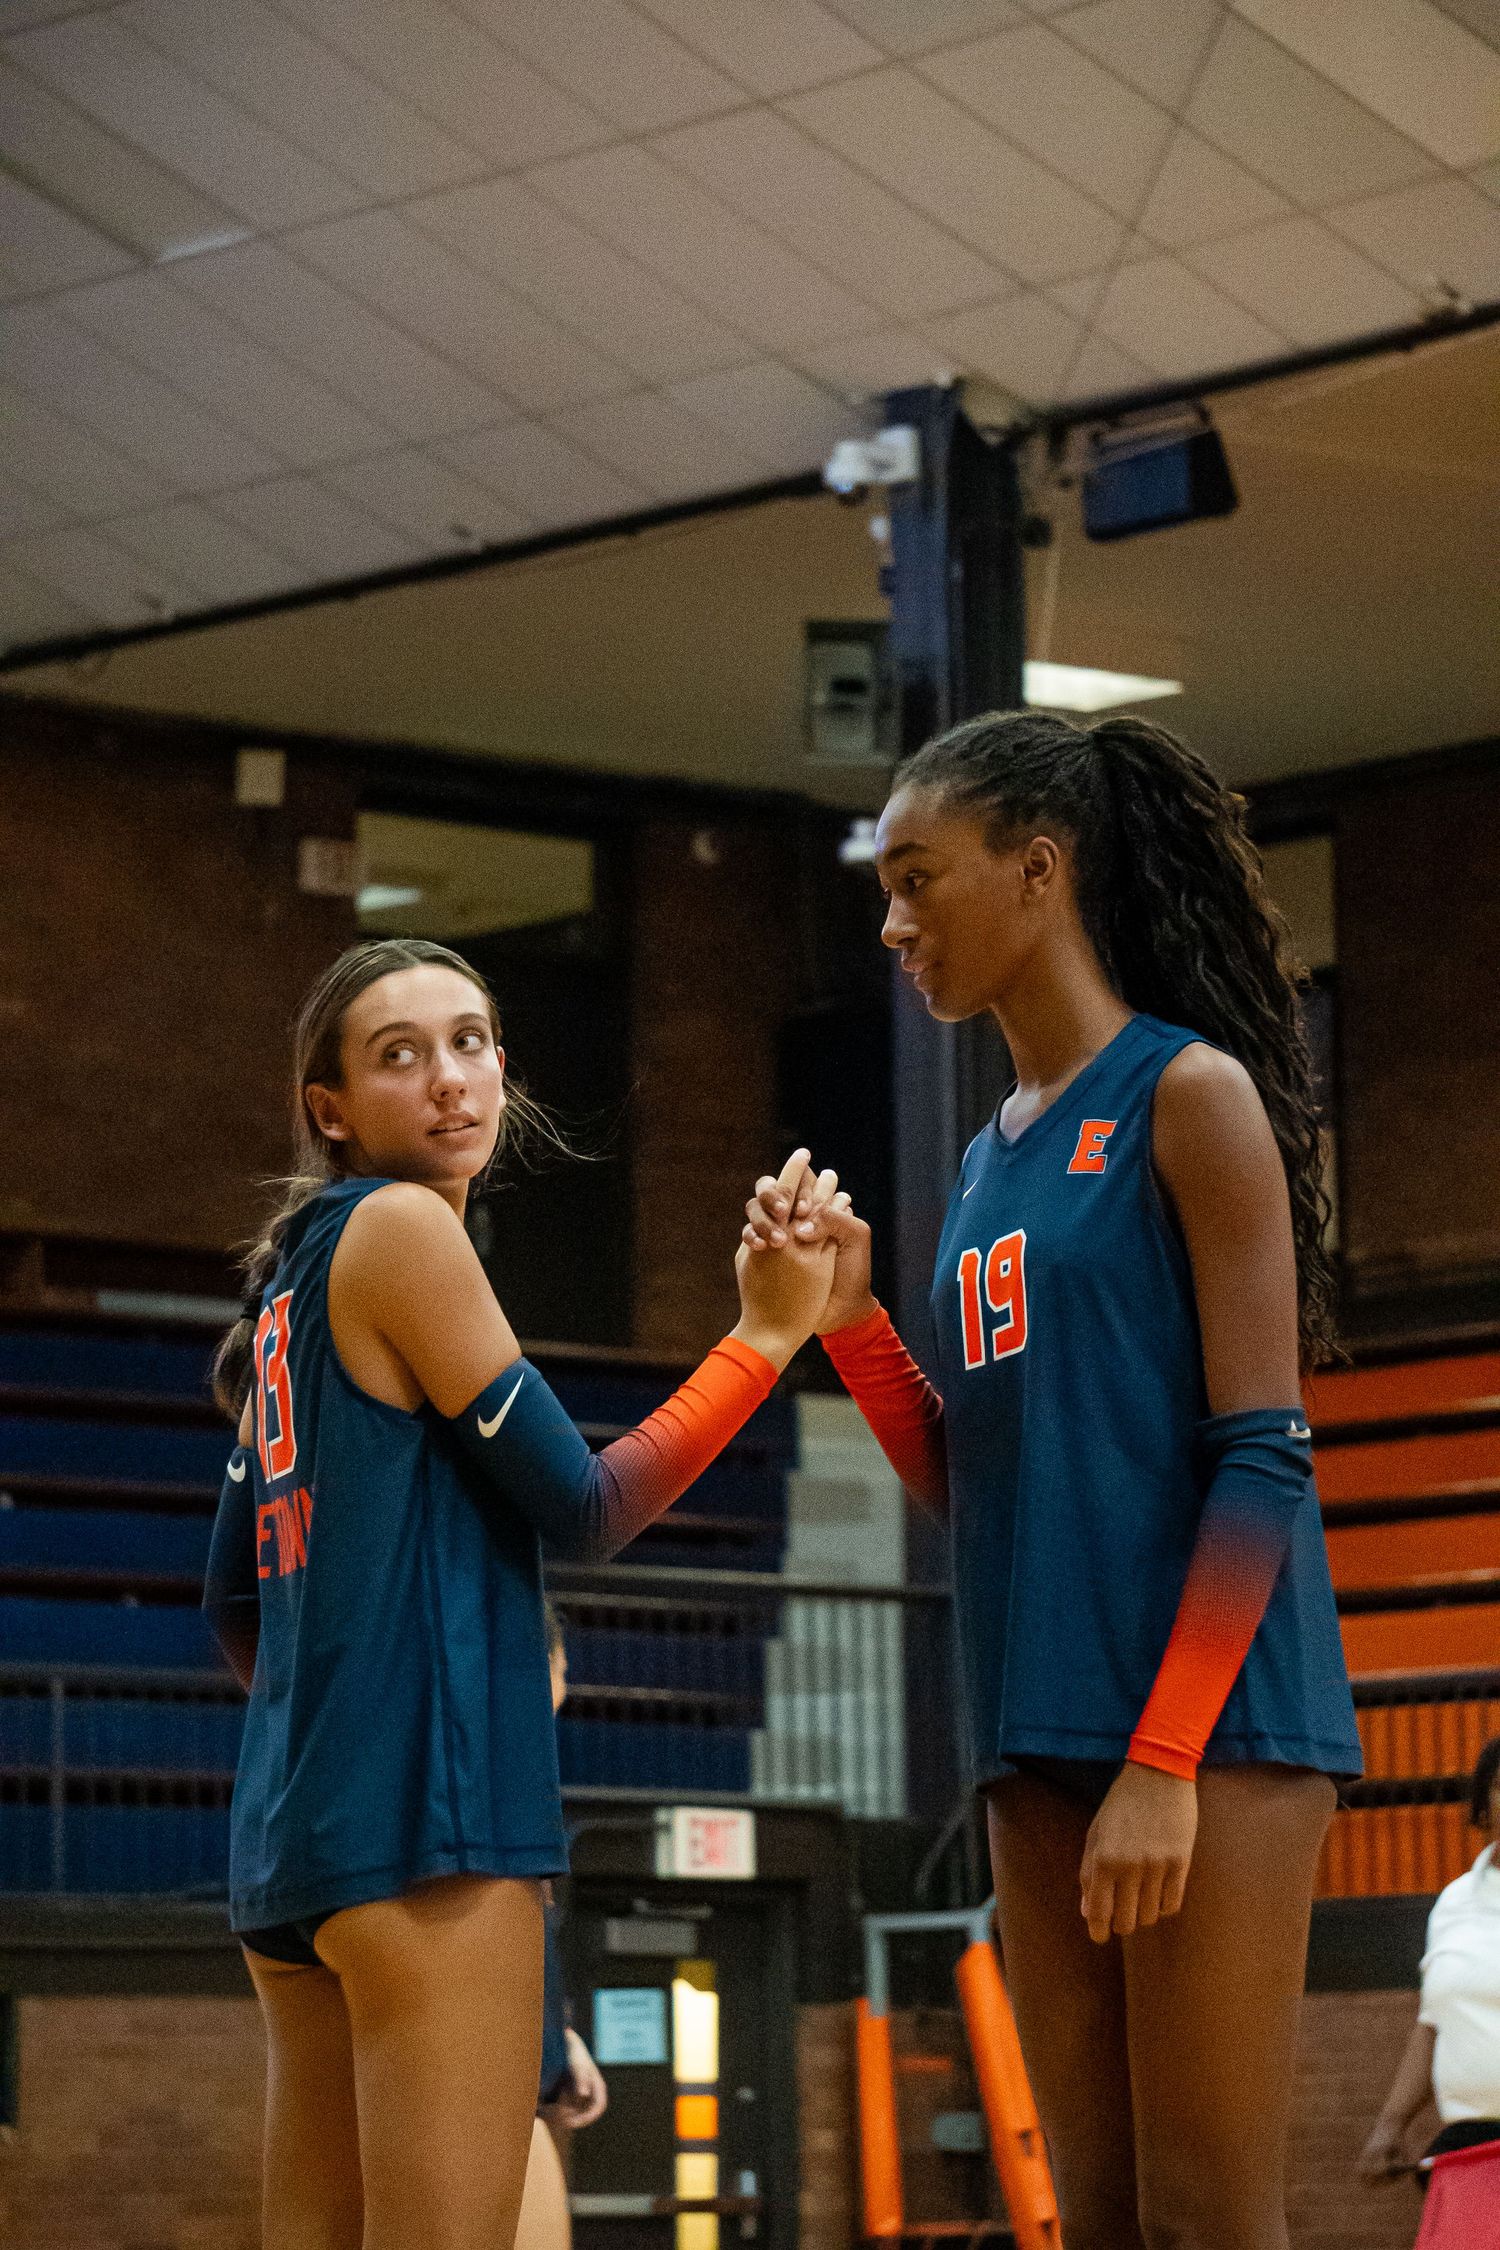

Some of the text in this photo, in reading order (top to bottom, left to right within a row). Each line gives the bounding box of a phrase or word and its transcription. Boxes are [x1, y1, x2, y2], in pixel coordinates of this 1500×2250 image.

[1067, 1119, 1118, 1174] E
[957, 1229, 1027, 1370] 19
[254, 1289, 297, 1484] 13
